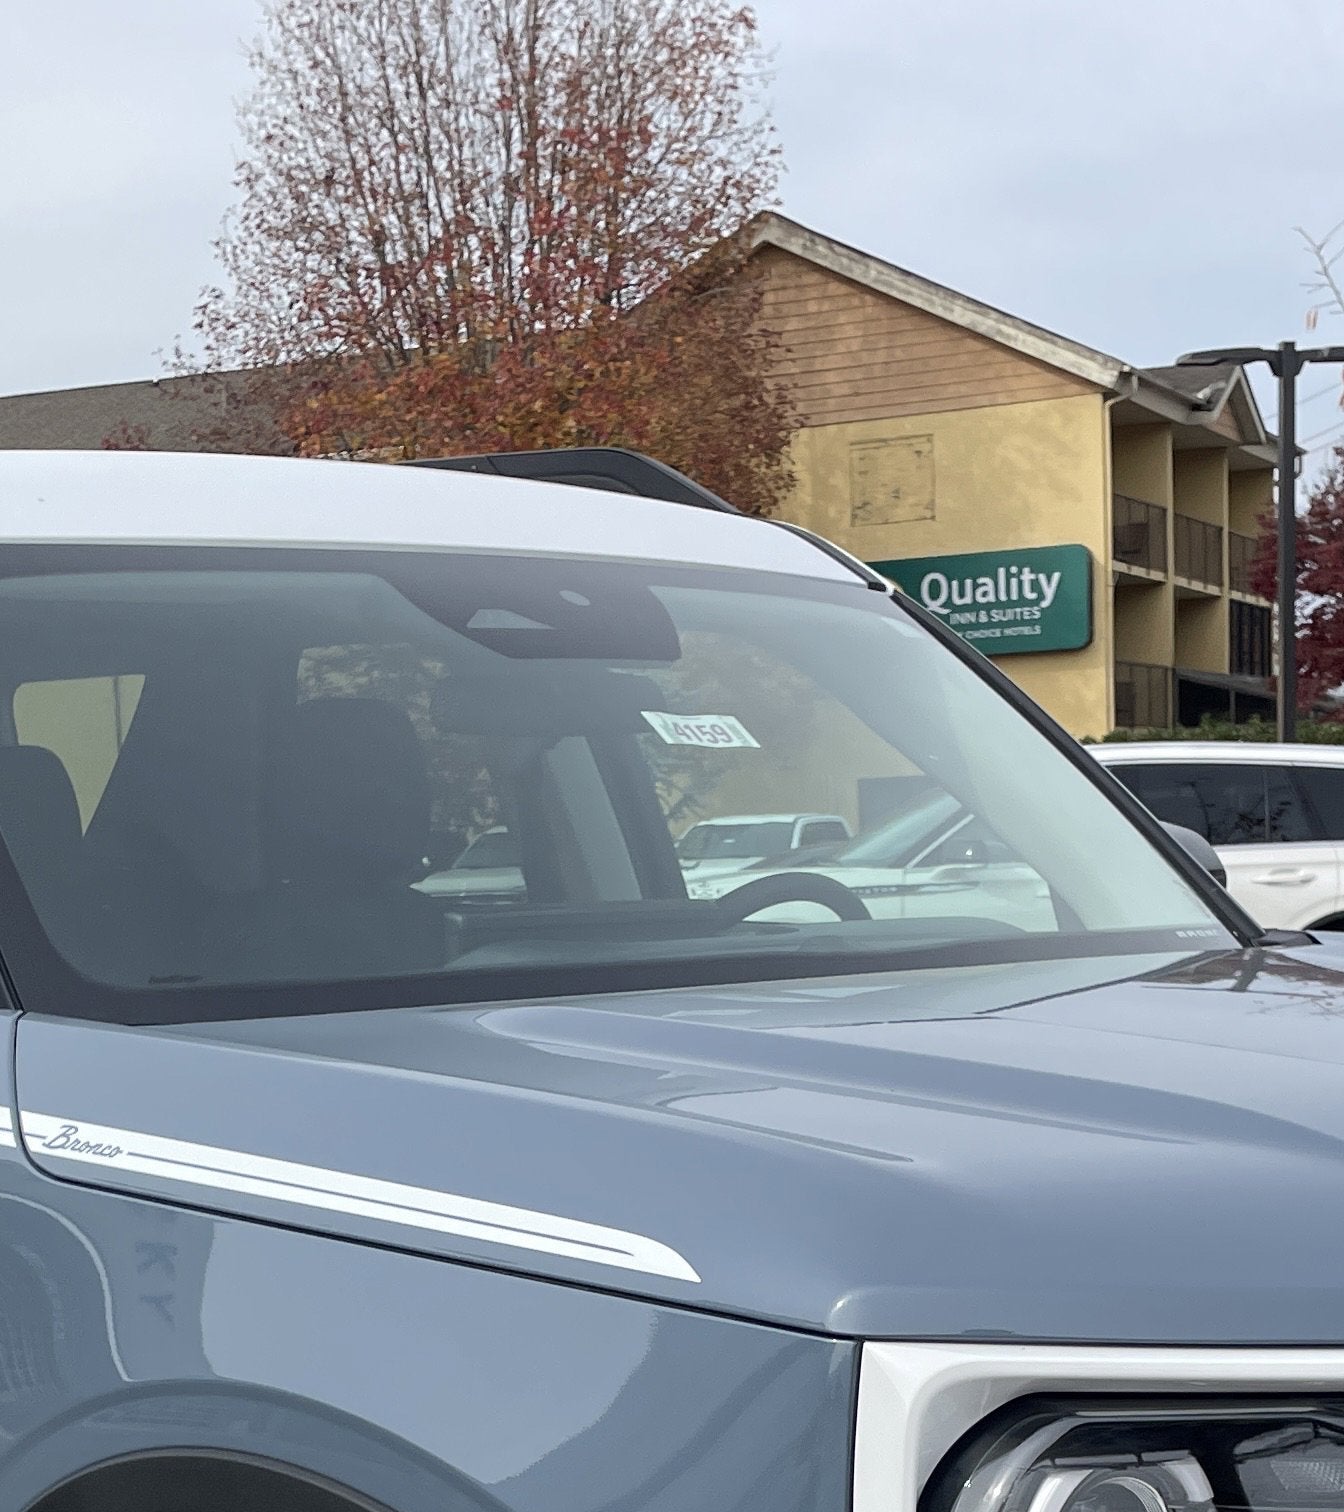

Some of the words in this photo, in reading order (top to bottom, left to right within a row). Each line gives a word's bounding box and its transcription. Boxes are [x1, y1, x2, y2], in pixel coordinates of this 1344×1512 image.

[920, 565, 1062, 615] Quality
[949, 611, 977, 625] INN
[977, 609, 989, 623] &
[989, 606, 1042, 623] SUITES
[964, 627, 1001, 640] CHOICE
[1003, 625, 1042, 637] HOTELS
[673, 722, 734, 745] 4159
[42, 1124, 124, 1158] Bronco
